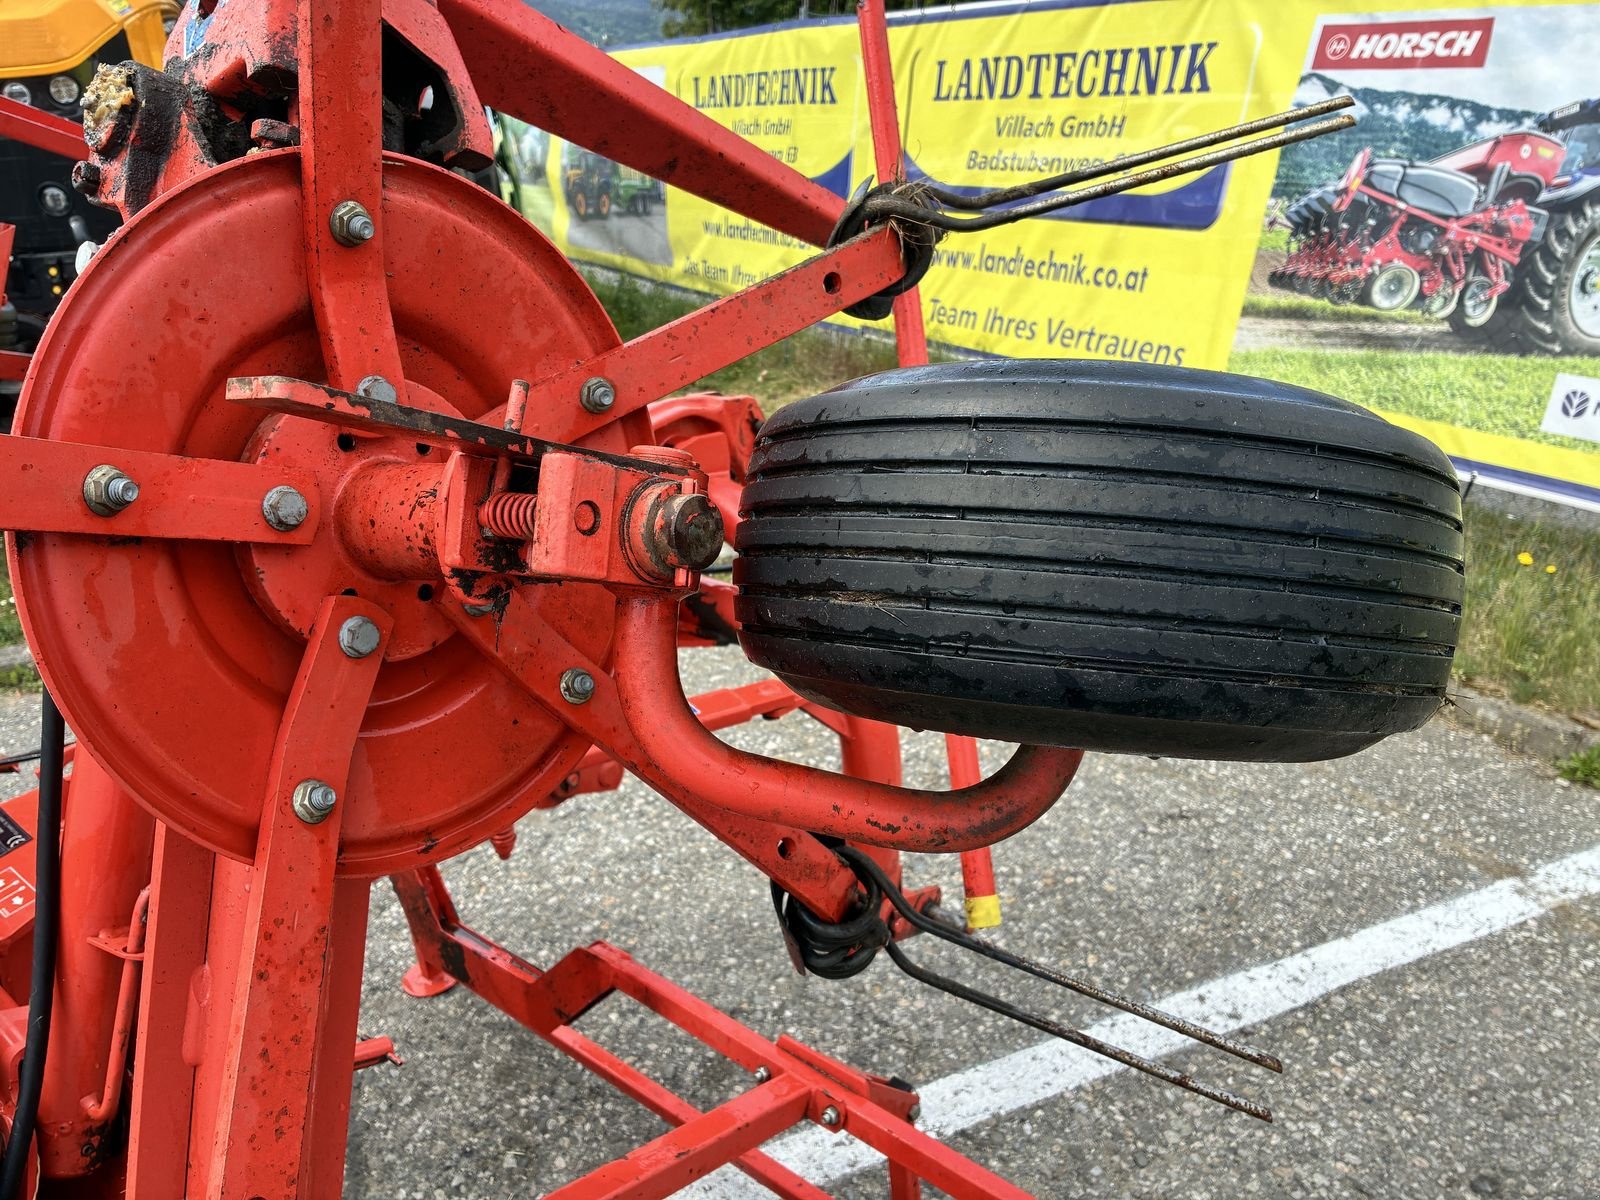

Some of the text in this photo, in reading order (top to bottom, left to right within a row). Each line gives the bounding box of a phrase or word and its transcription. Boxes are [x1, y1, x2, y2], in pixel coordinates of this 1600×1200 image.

[1350, 30, 1483, 59] HORSCH
[693, 67, 837, 108] LANDTECHNIK
[933, 42, 1217, 101] LANDTECHNIK
[763, 116, 792, 136] GmbH
[996, 115, 1127, 138] Villach GmbH
[701, 259, 729, 283] Team
[932, 242, 1149, 293] www.landtechnik.co.at
[929, 297, 1187, 367] Team Ihres Vertrauens
